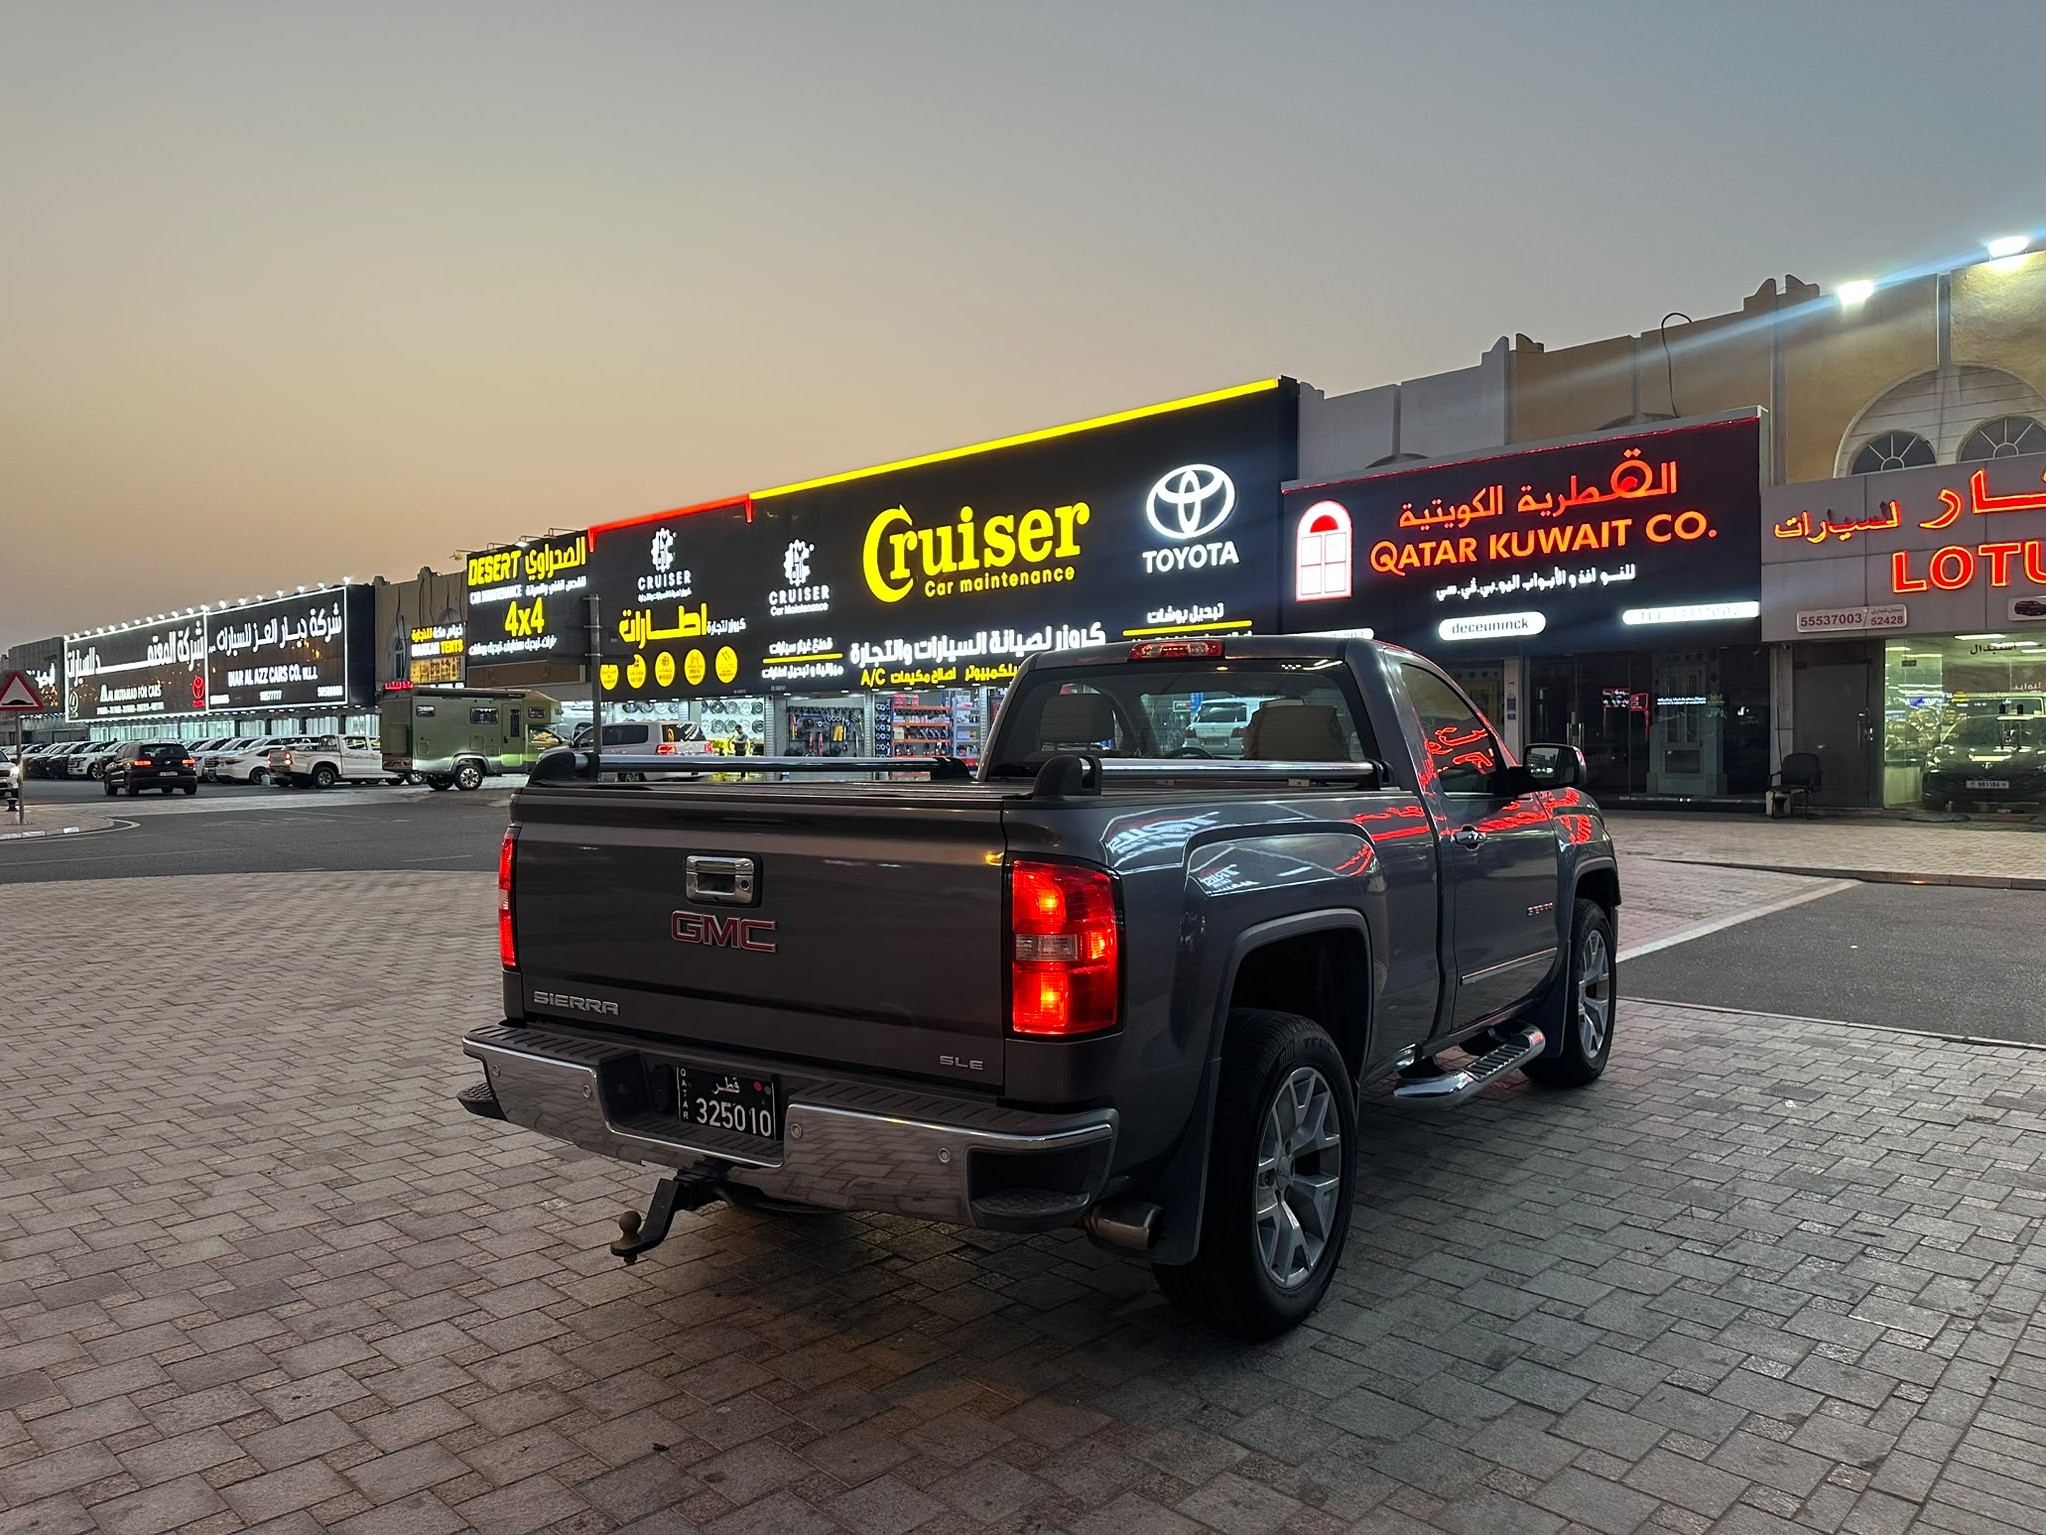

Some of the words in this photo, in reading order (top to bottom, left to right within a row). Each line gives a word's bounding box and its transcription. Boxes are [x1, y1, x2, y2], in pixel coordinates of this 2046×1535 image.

[1517, 447, 1678, 518] القطرية
[1398, 484, 1504, 532] الكويتية
[863, 502, 1091, 603] Cruiser
[1142, 541, 1240, 574] TOYOTA
[1370, 536, 1478, 576] QATAR
[1489, 518, 1633, 560] KUWAIT
[1645, 510, 1718, 543] CO.
[468, 550, 522, 586] DESERT
[638, 570, 691, 591] CRUISER
[924, 580, 954, 598] Car
[960, 566, 1076, 593] maintenance
[769, 585, 830, 606] CRUISER
[309, 602, 342, 643] شركة
[504, 597, 545, 637] 4x4
[1800, 613, 1862, 627] 55537003
[1870, 616, 1904, 626] 52428
[914, 631, 987, 663] السيارات
[989, 625, 1052, 658] لصيانة
[1055, 621, 1106, 652] كروزر
[861, 667, 886, 688] A/C
[671, 909, 777, 953] GMC
[533, 990, 620, 1017] SIERRA
[940, 1055, 984, 1070] SLE
[680, 1068, 689, 1120] QATAR
[711, 1075, 740, 1095] قطر
[696, 1097, 772, 1137] 325010
